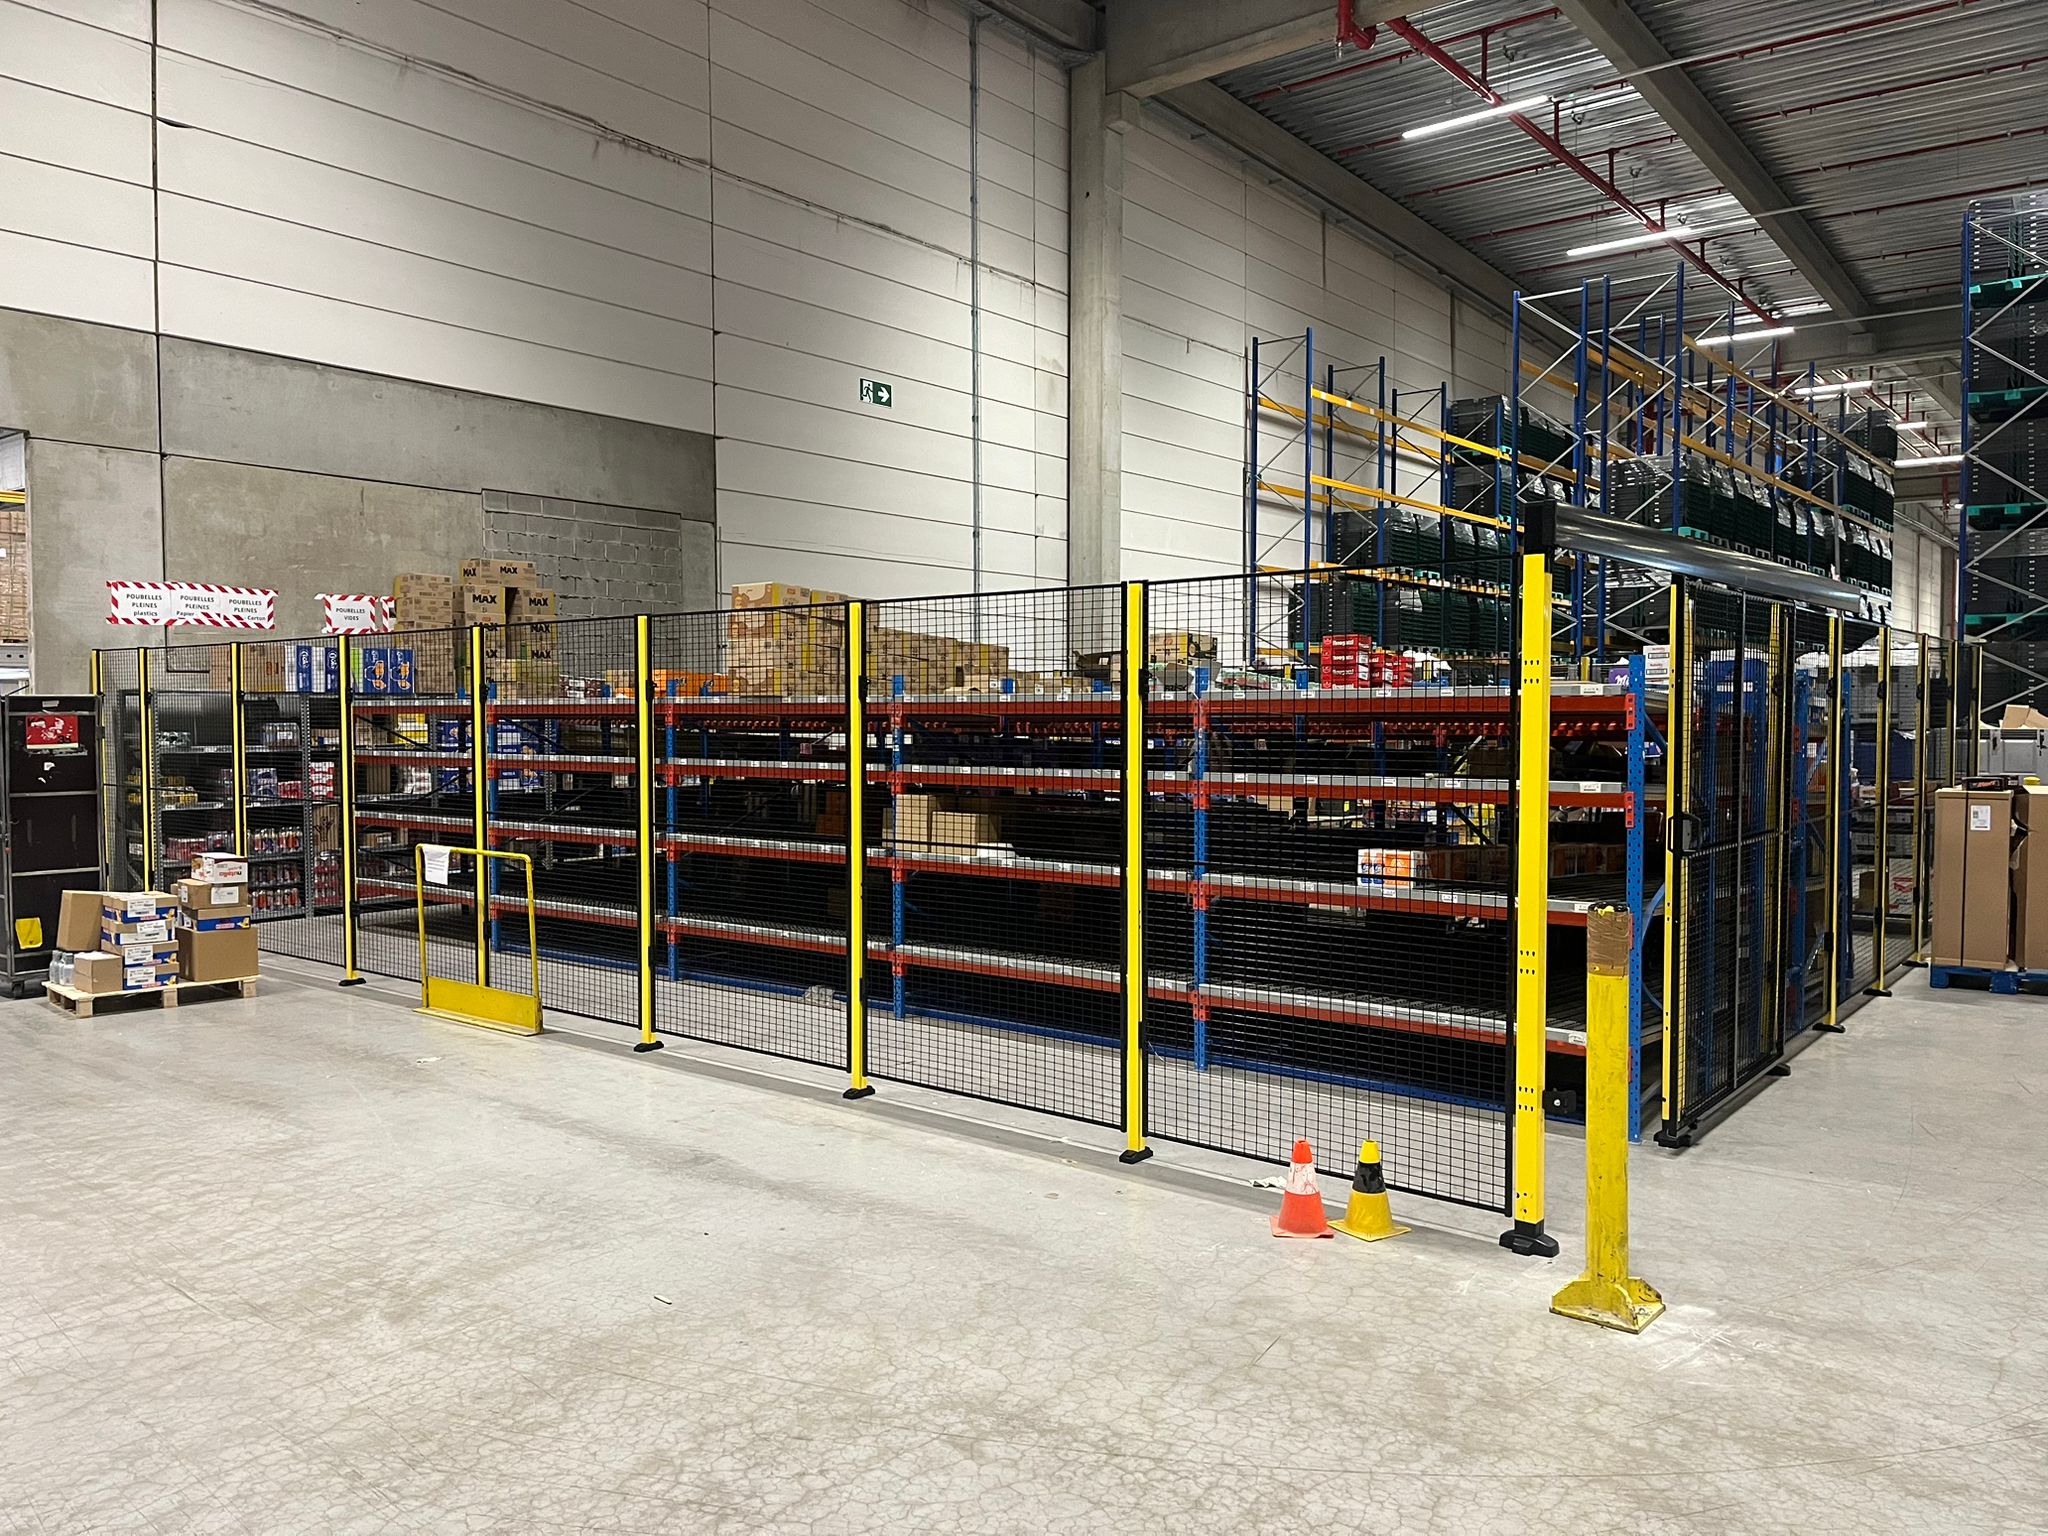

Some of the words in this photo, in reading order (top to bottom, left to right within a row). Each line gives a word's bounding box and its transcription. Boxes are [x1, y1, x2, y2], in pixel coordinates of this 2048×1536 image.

[463, 567, 477, 577] MAX
[500, 566, 518, 575] MAX
[126, 593, 163, 601] POUBELLES
[180, 595, 215, 603] POUBELLES
[473, 593, 497, 605] MAX
[529, 597, 549, 607] MAX
